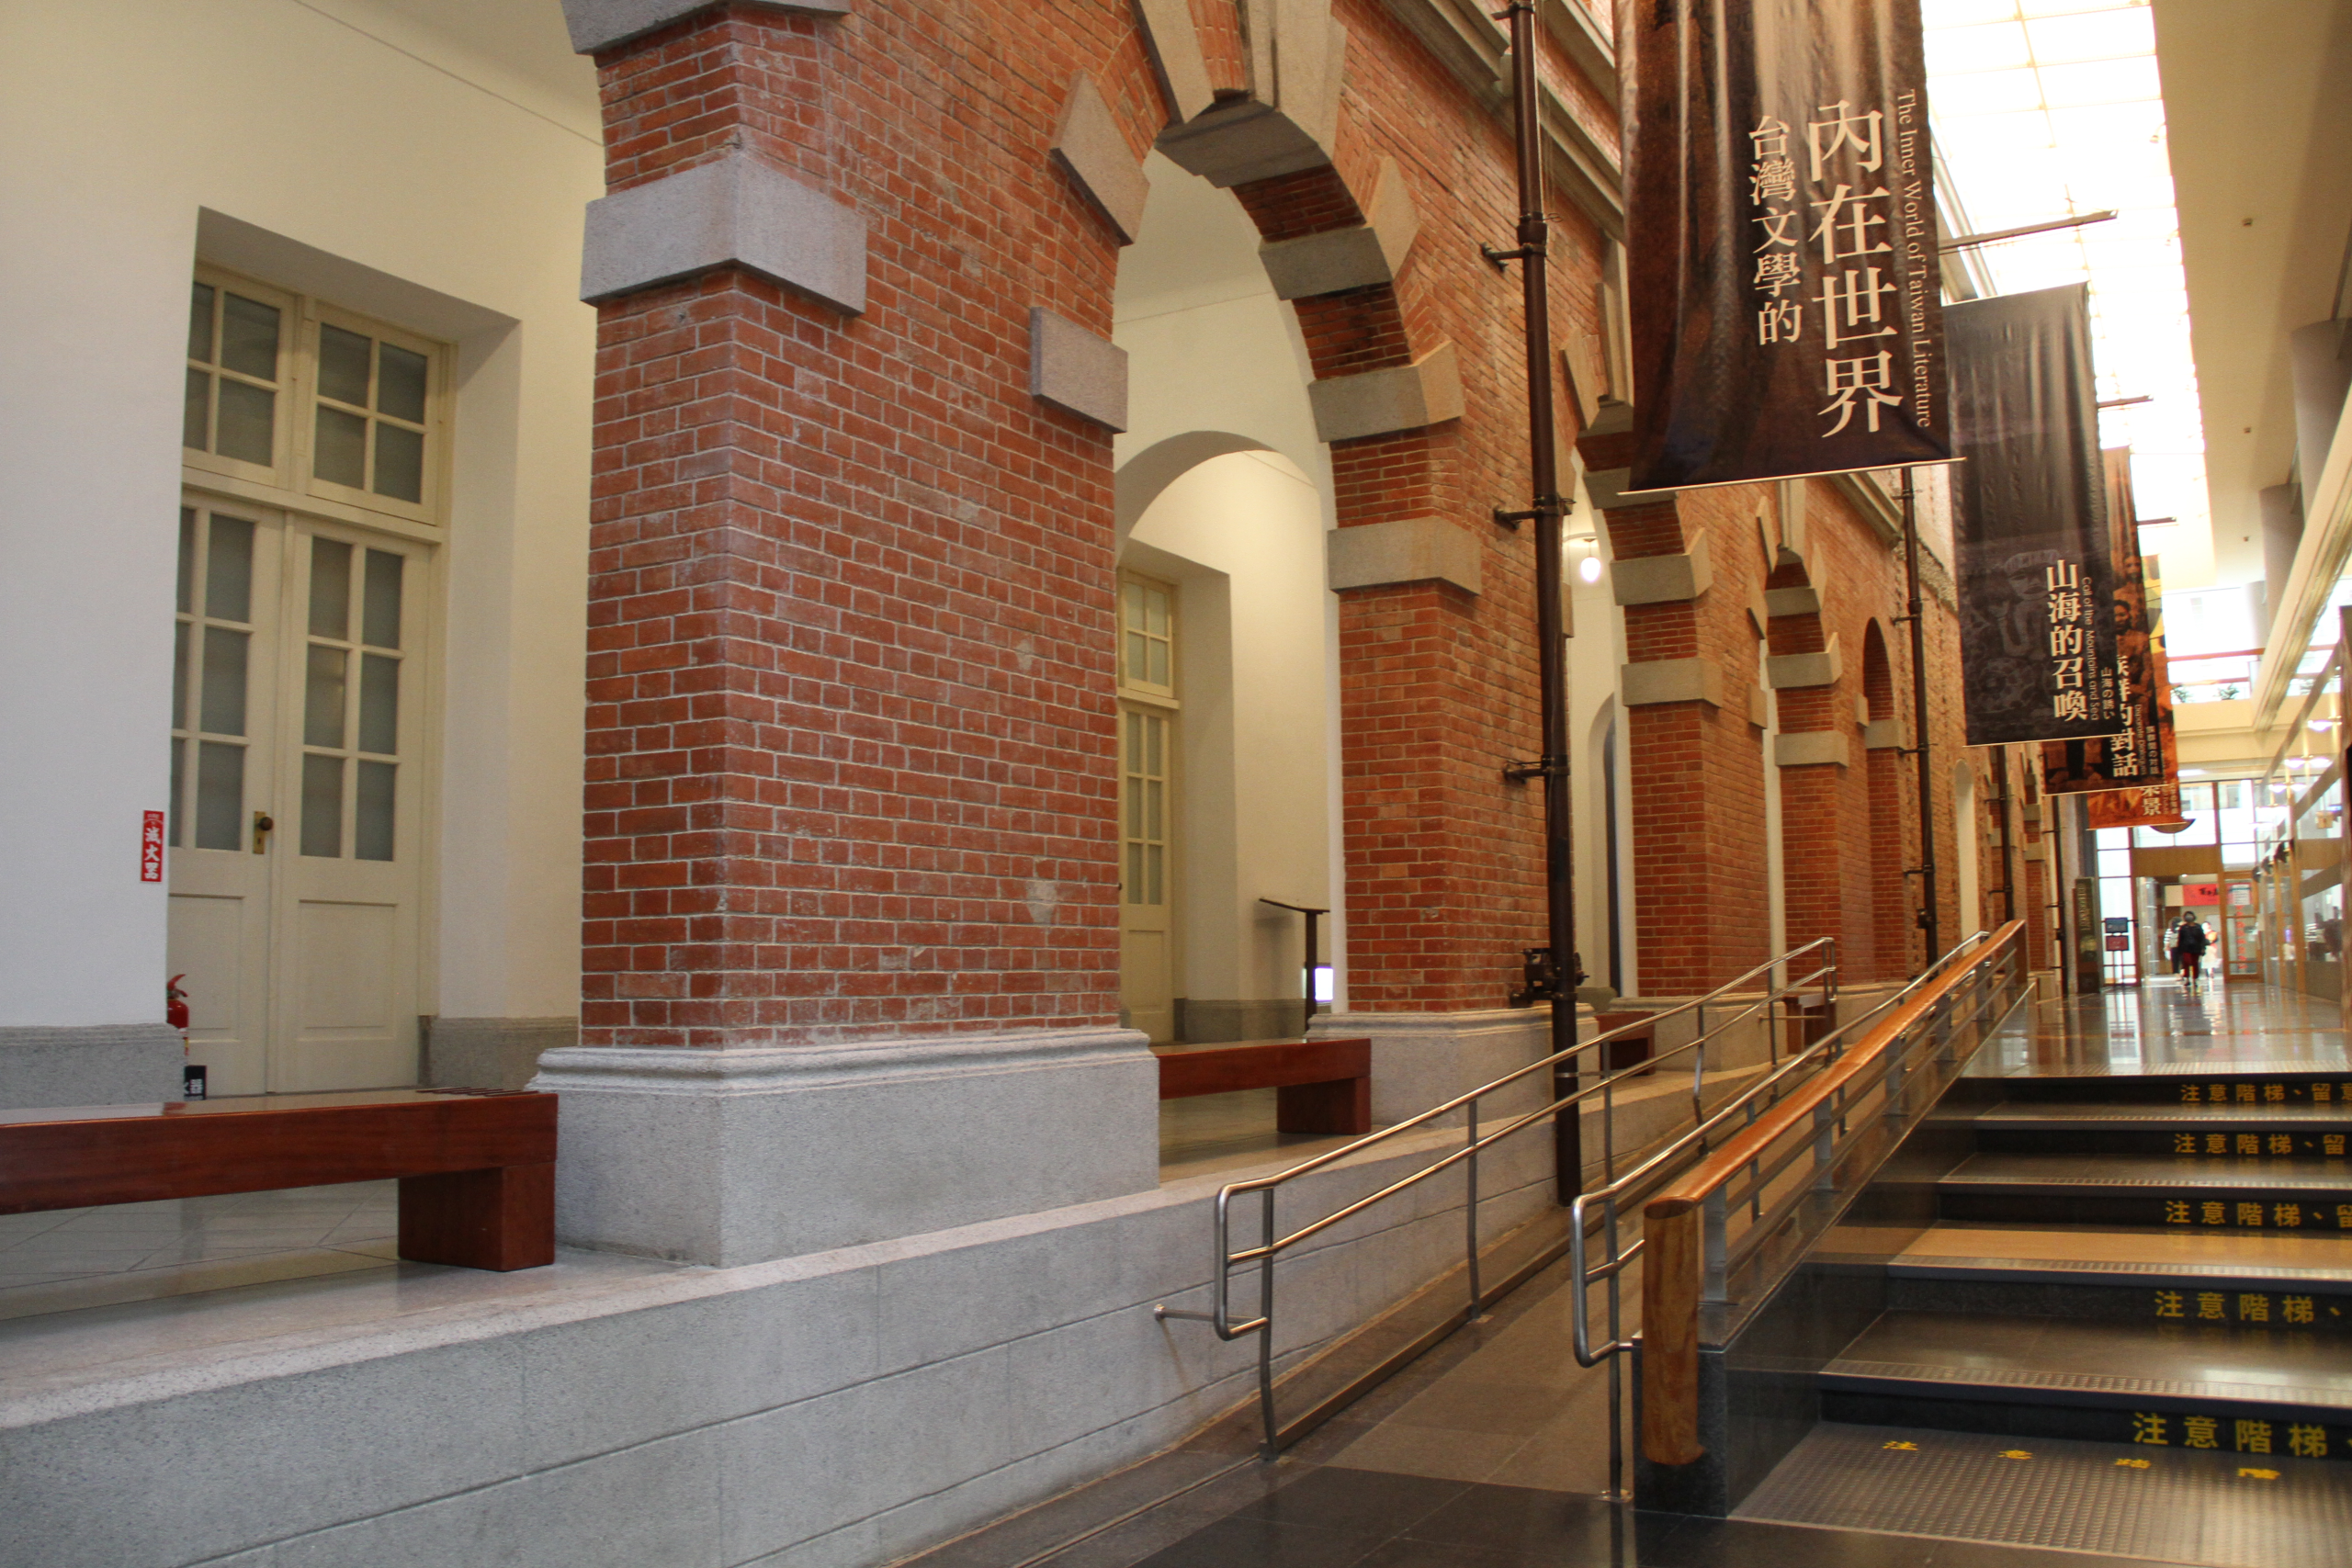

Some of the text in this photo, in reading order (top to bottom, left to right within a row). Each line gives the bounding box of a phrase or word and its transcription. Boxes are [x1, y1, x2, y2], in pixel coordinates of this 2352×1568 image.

[1748, 115, 1803, 345] 台灣文學的
[1808, 99, 1903, 438] 內在世界
[1897, 88, 1933, 428] The Inner World of Taiwan Literature
[2046, 559, 2089, 722] 山海的召喚
[2081, 576, 2101, 721] Call of the Mountains and Sea
